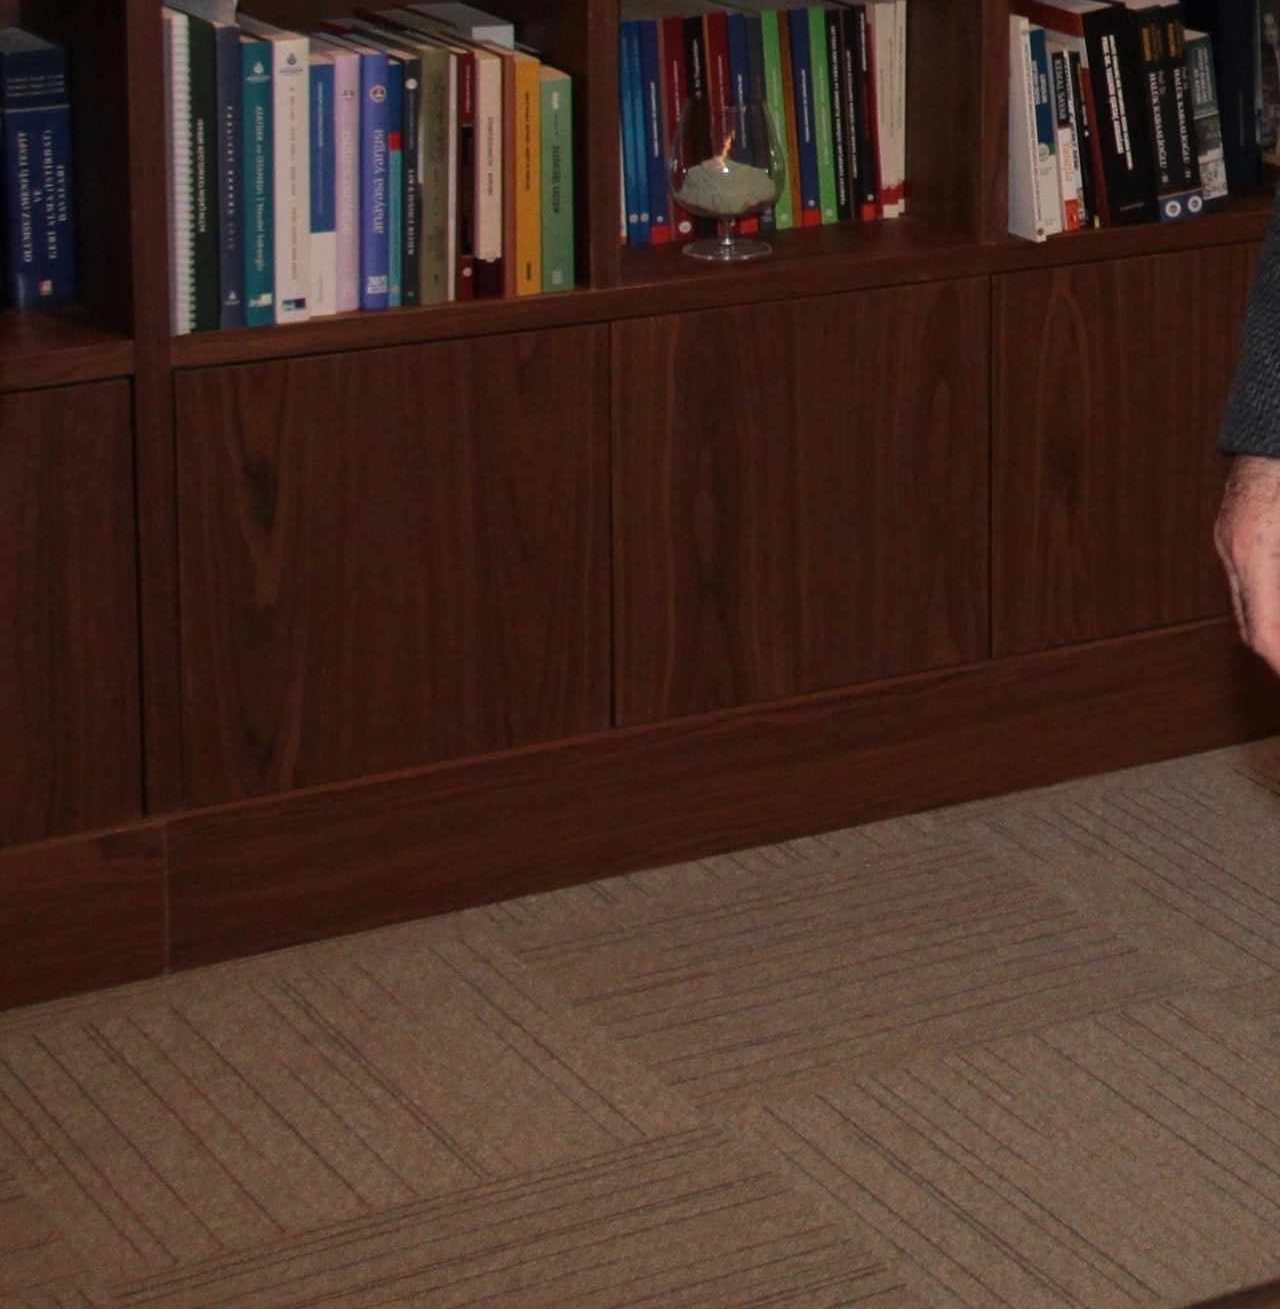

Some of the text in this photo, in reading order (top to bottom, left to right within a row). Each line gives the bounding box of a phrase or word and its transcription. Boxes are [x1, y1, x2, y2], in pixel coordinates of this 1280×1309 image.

[1053, 58, 1067, 121] KEMAL SAYAR
[1151, 105, 1167, 169] KABAALİOĞLU
[1175, 100, 1190, 165] KABAALİOĞLU
[32, 189, 44, 203] VE
[43, 193, 57, 228] ALMA
[55, 163, 68, 222] DAVALARI
[370, 128, 387, 235] anayasa yargısı
[45, 230, 59, 260] GERİ
